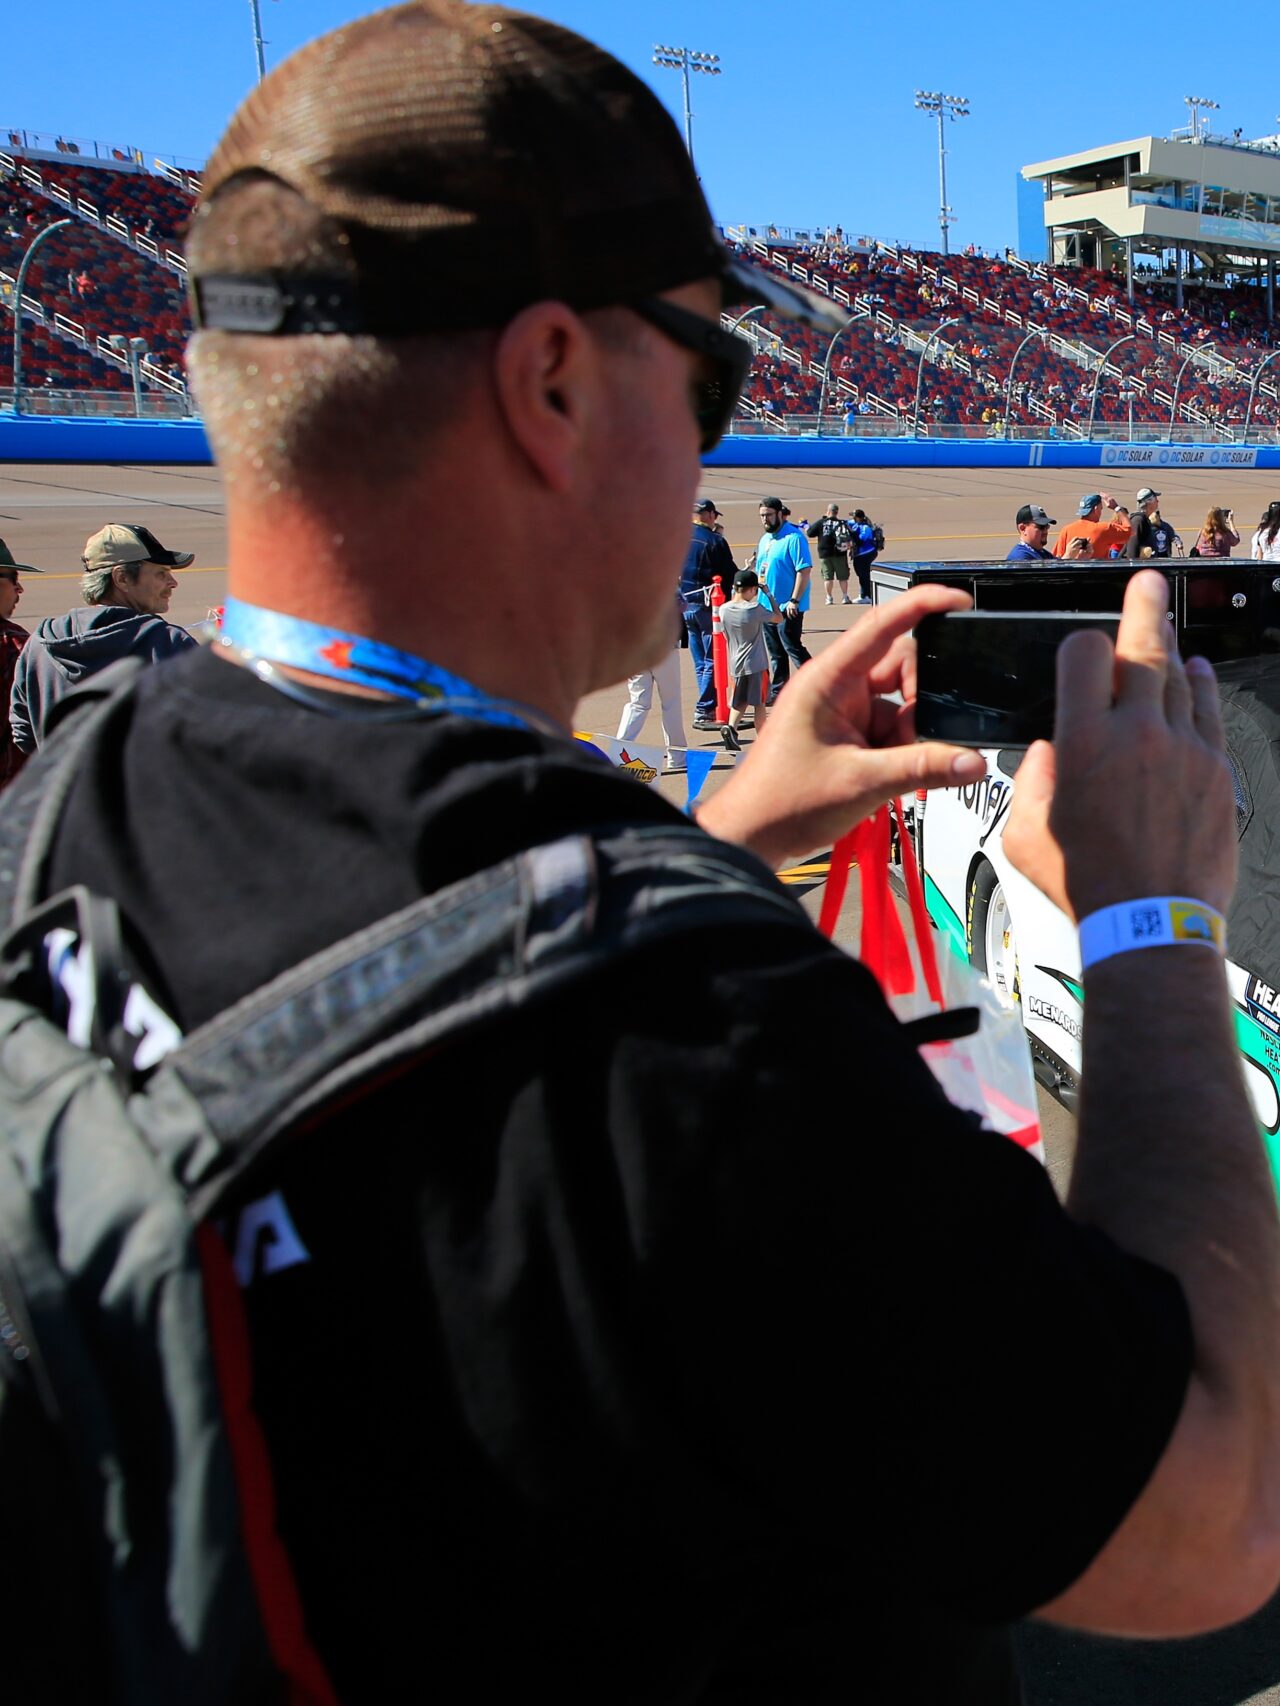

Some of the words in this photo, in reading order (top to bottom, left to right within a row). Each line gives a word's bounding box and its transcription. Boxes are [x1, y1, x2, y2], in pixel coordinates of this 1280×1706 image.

[1128, 450, 1153, 462] SOLAR
[1180, 451, 1204, 463] SOLAR
[1231, 452, 1253, 463] SOLAR
[1029, 996, 1083, 1040] MENARDS
